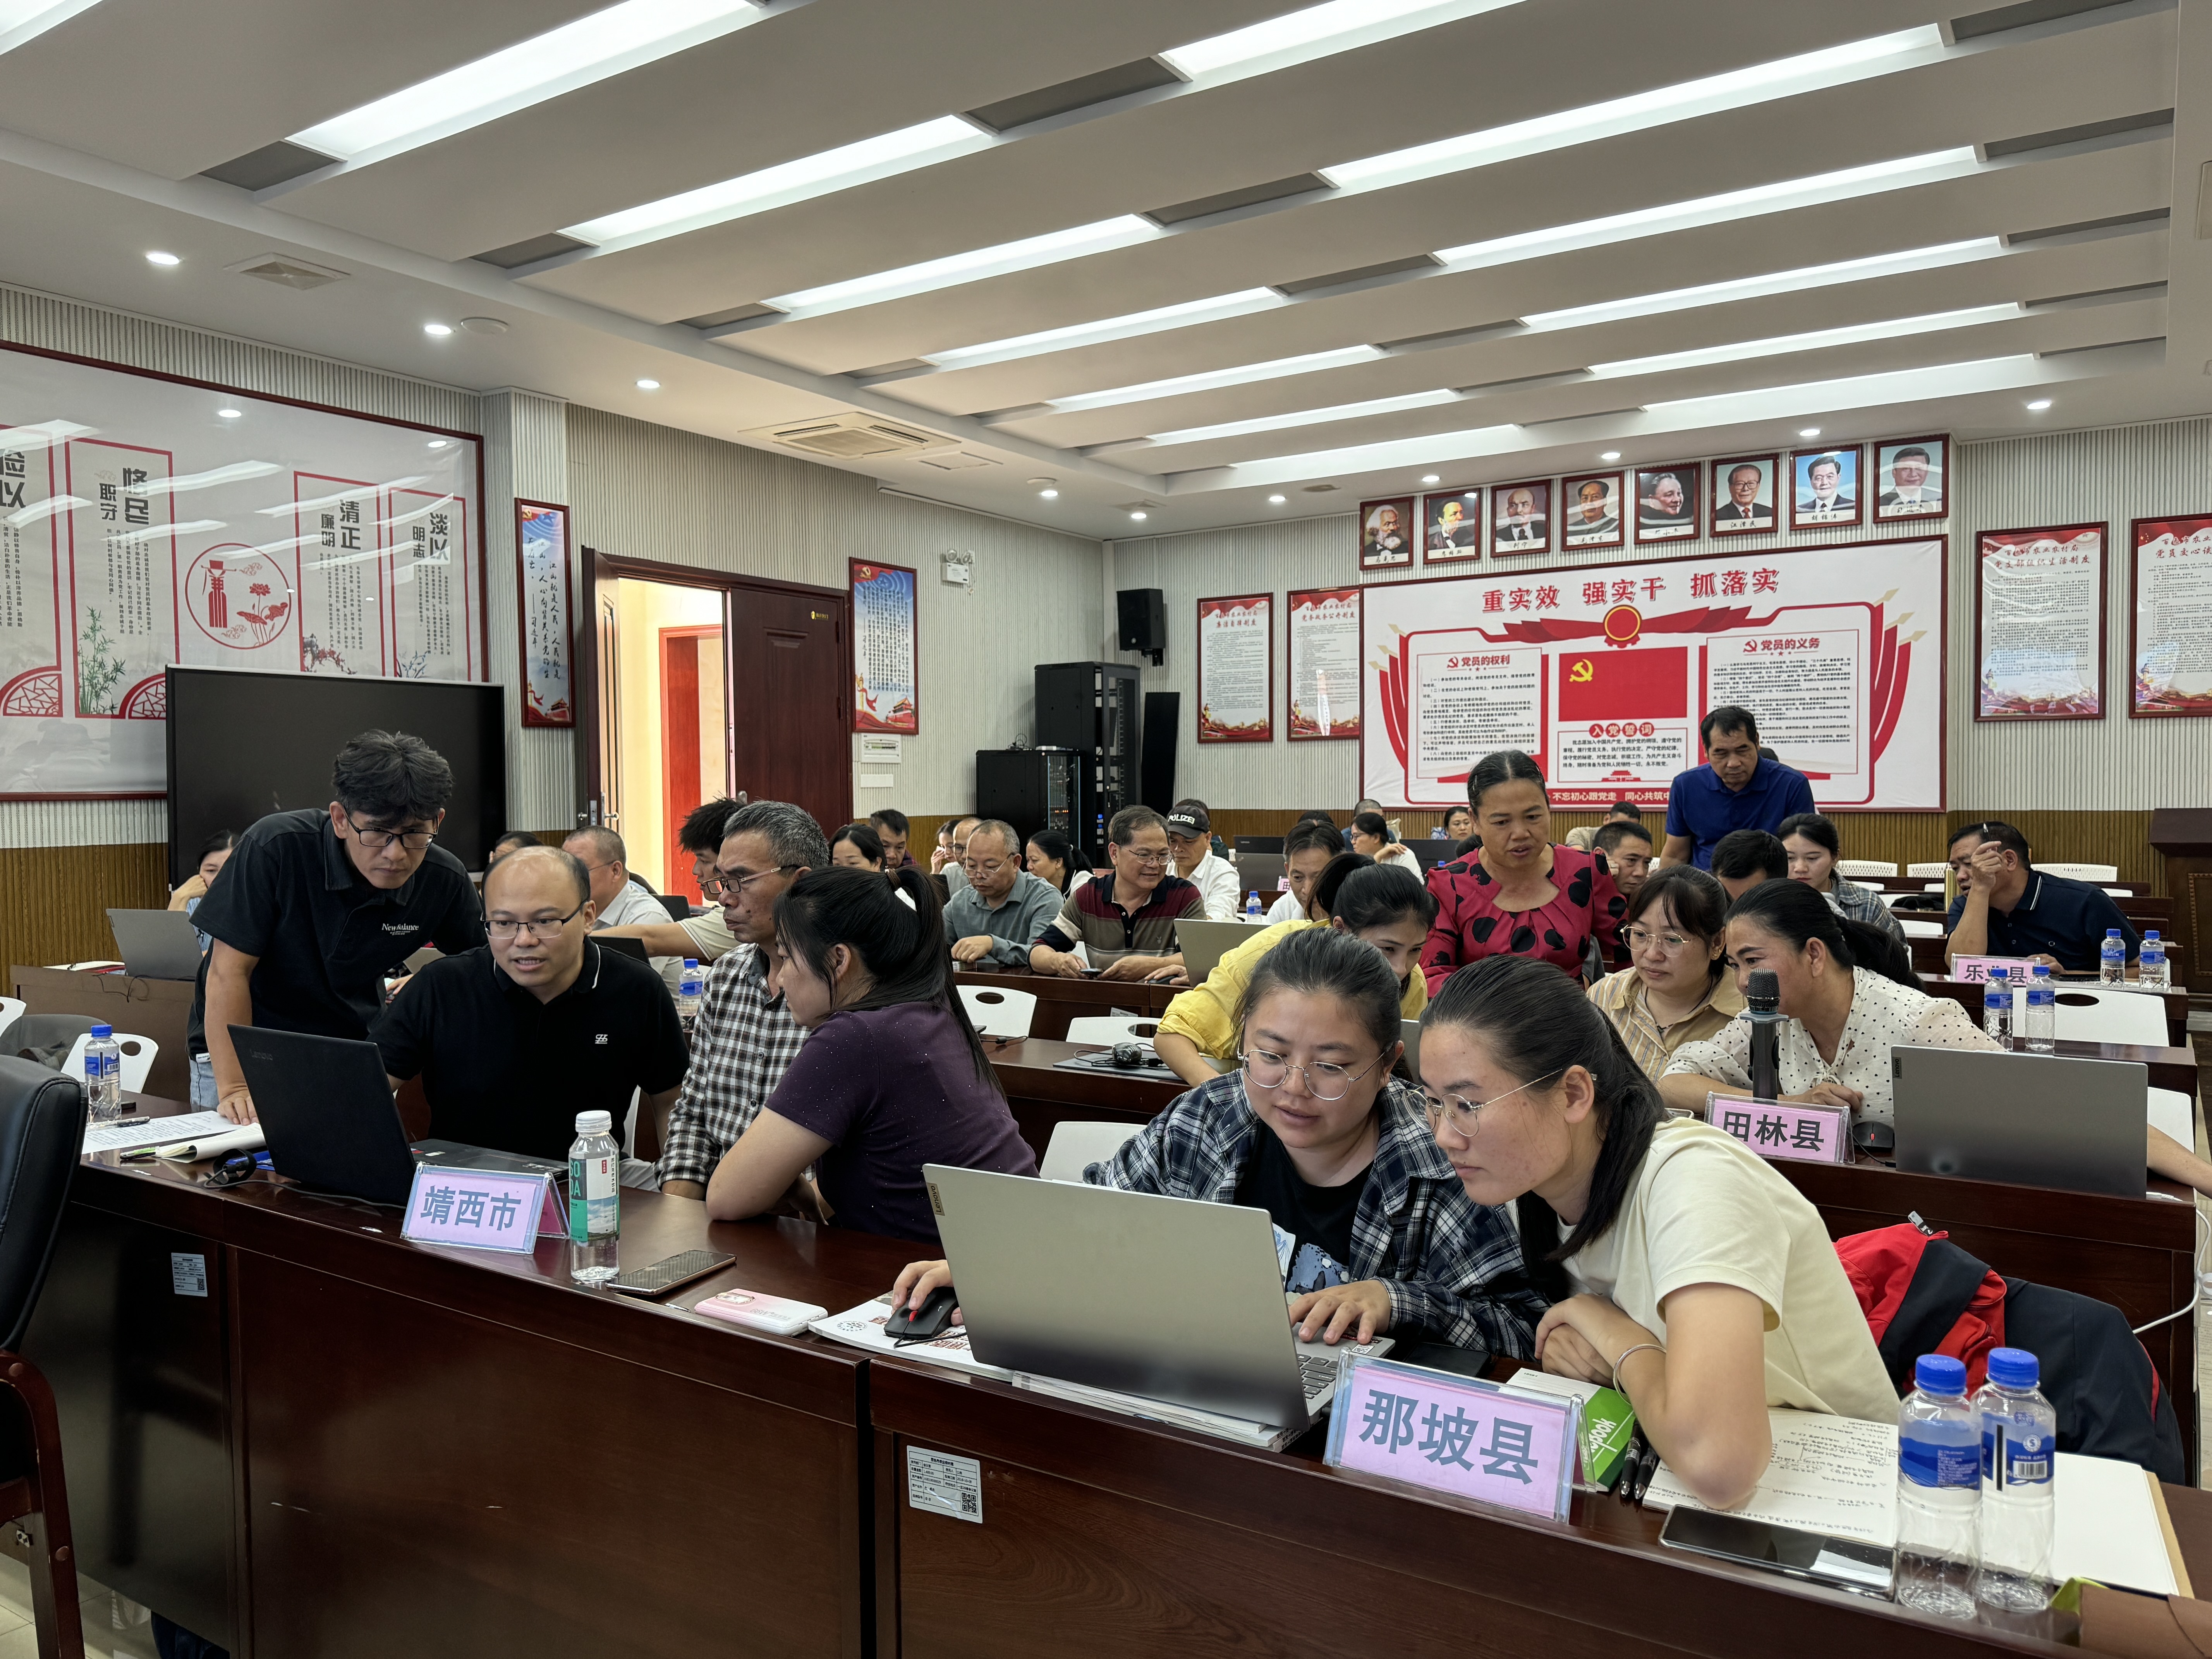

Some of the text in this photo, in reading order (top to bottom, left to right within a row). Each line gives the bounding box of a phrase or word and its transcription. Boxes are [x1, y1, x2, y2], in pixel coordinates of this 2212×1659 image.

[100, 483, 118, 521] 职守
[123, 467, 149, 525] 恪尽
[321, 513, 335, 548] 廉明
[339, 499, 361, 551] 清正
[412, 525, 426, 559] 明志
[429, 512, 449, 562] 淡以
[1481, 567, 1780, 614] 重实效 强实干 抓落实
[1461, 654, 1510, 667] 党员的权利
[1760, 637, 1820, 651] 党员的义务
[1591, 723, 1652, 736] 入党誓词
[1553, 792, 1616, 801] 不忘初心跟党走
[1723, 1110, 1824, 1152] 田林县
[420, 1185, 522, 1231] 靖西市
[931, 1185, 941, 1213] Lenovo
[1358, 1388, 1539, 1485] 那坡县
